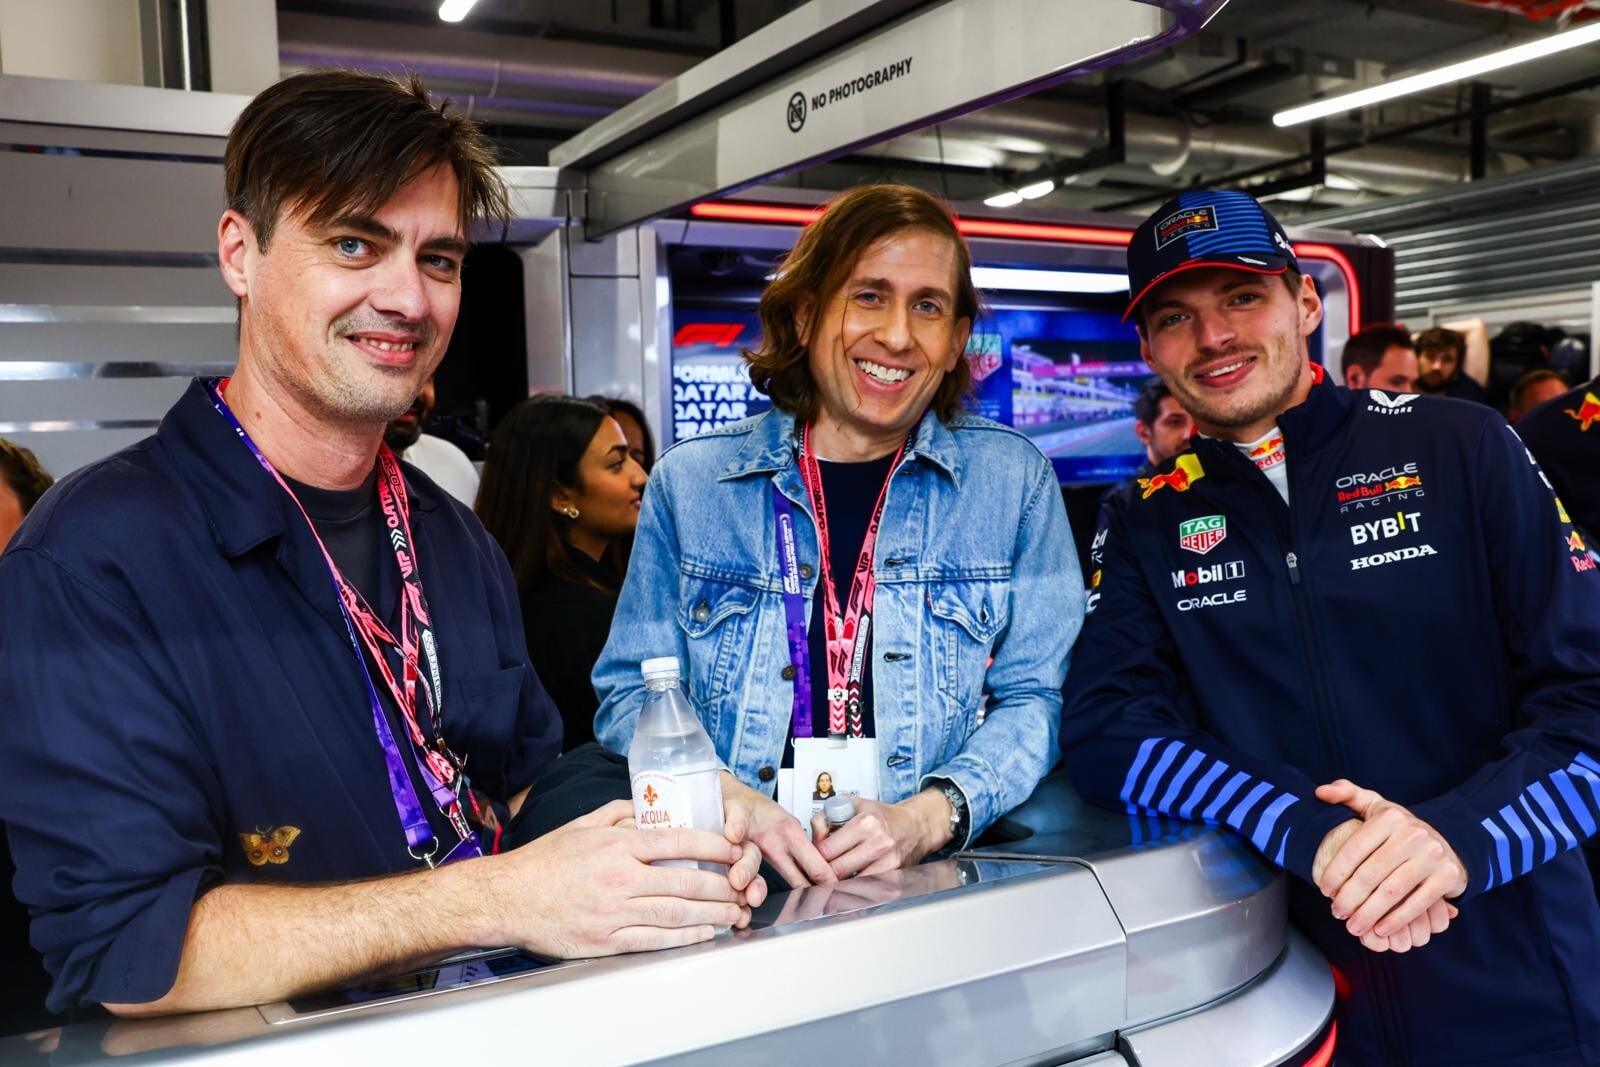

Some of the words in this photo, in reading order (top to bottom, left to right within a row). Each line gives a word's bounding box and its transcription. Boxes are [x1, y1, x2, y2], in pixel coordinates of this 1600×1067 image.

[811, 93, 827, 111] NO
[829, 56, 913, 104] PHOTOGRAPHY
[1160, 209, 1207, 230] ORACLE
[1367, 404, 1413, 415] CASTORE
[1336, 462, 1419, 488] ORACLE
[1340, 489, 1425, 514] RACING
[1183, 517, 1222, 533] TAG
[1350, 511, 1421, 545] BYBIT
[1182, 530, 1223, 551] HEUER
[396, 550, 413, 579] VIP
[857, 551, 870, 573] VIP
[1350, 544, 1438, 570] HONDA
[1171, 564, 1223, 588] Mobil
[1177, 589, 1247, 611] ORACLE
[641, 809, 671, 824] ACQUA
